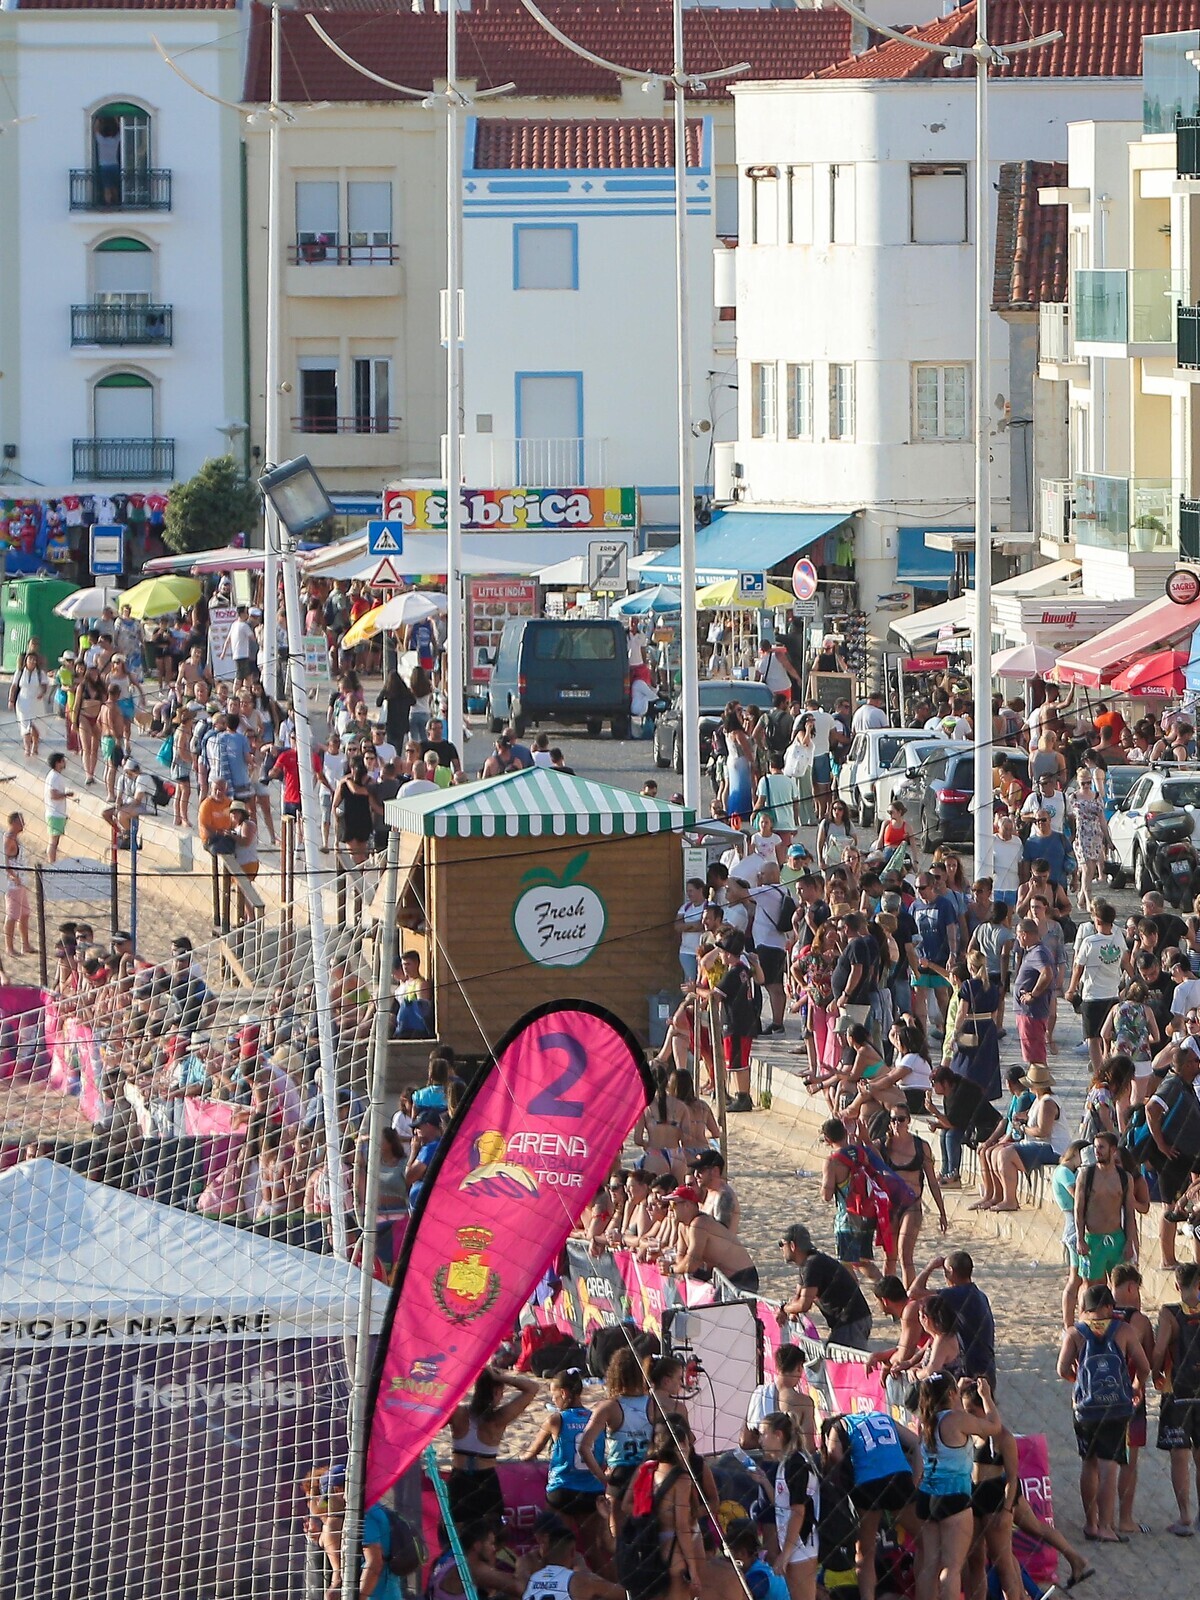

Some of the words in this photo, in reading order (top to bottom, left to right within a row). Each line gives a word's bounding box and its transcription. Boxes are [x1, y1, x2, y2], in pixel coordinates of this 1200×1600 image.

[389, 496, 416, 526] a
[600, 544, 617, 552] zona
[478, 586, 503, 597] LITTLE
[504, 586, 526, 598] INDIA
[743, 574, 755, 591] P
[1171, 582, 1196, 591] SAGRES
[1146, 686, 1166, 694] SAGRES
[534, 897, 585, 925] Fresh
[537, 923, 586, 947] Fruit
[527, 1032, 588, 1119] 2
[507, 1132, 589, 1159] ARENA
[505, 1152, 583, 1172] HANDBALL
[534, 1170, 584, 1188] TOUR
[65, 1318, 114, 1340] DA
[127, 1310, 271, 1337] NAZARÉ
[133, 1372, 304, 1408] helvetia
[856, 1416, 898, 1454] 15
